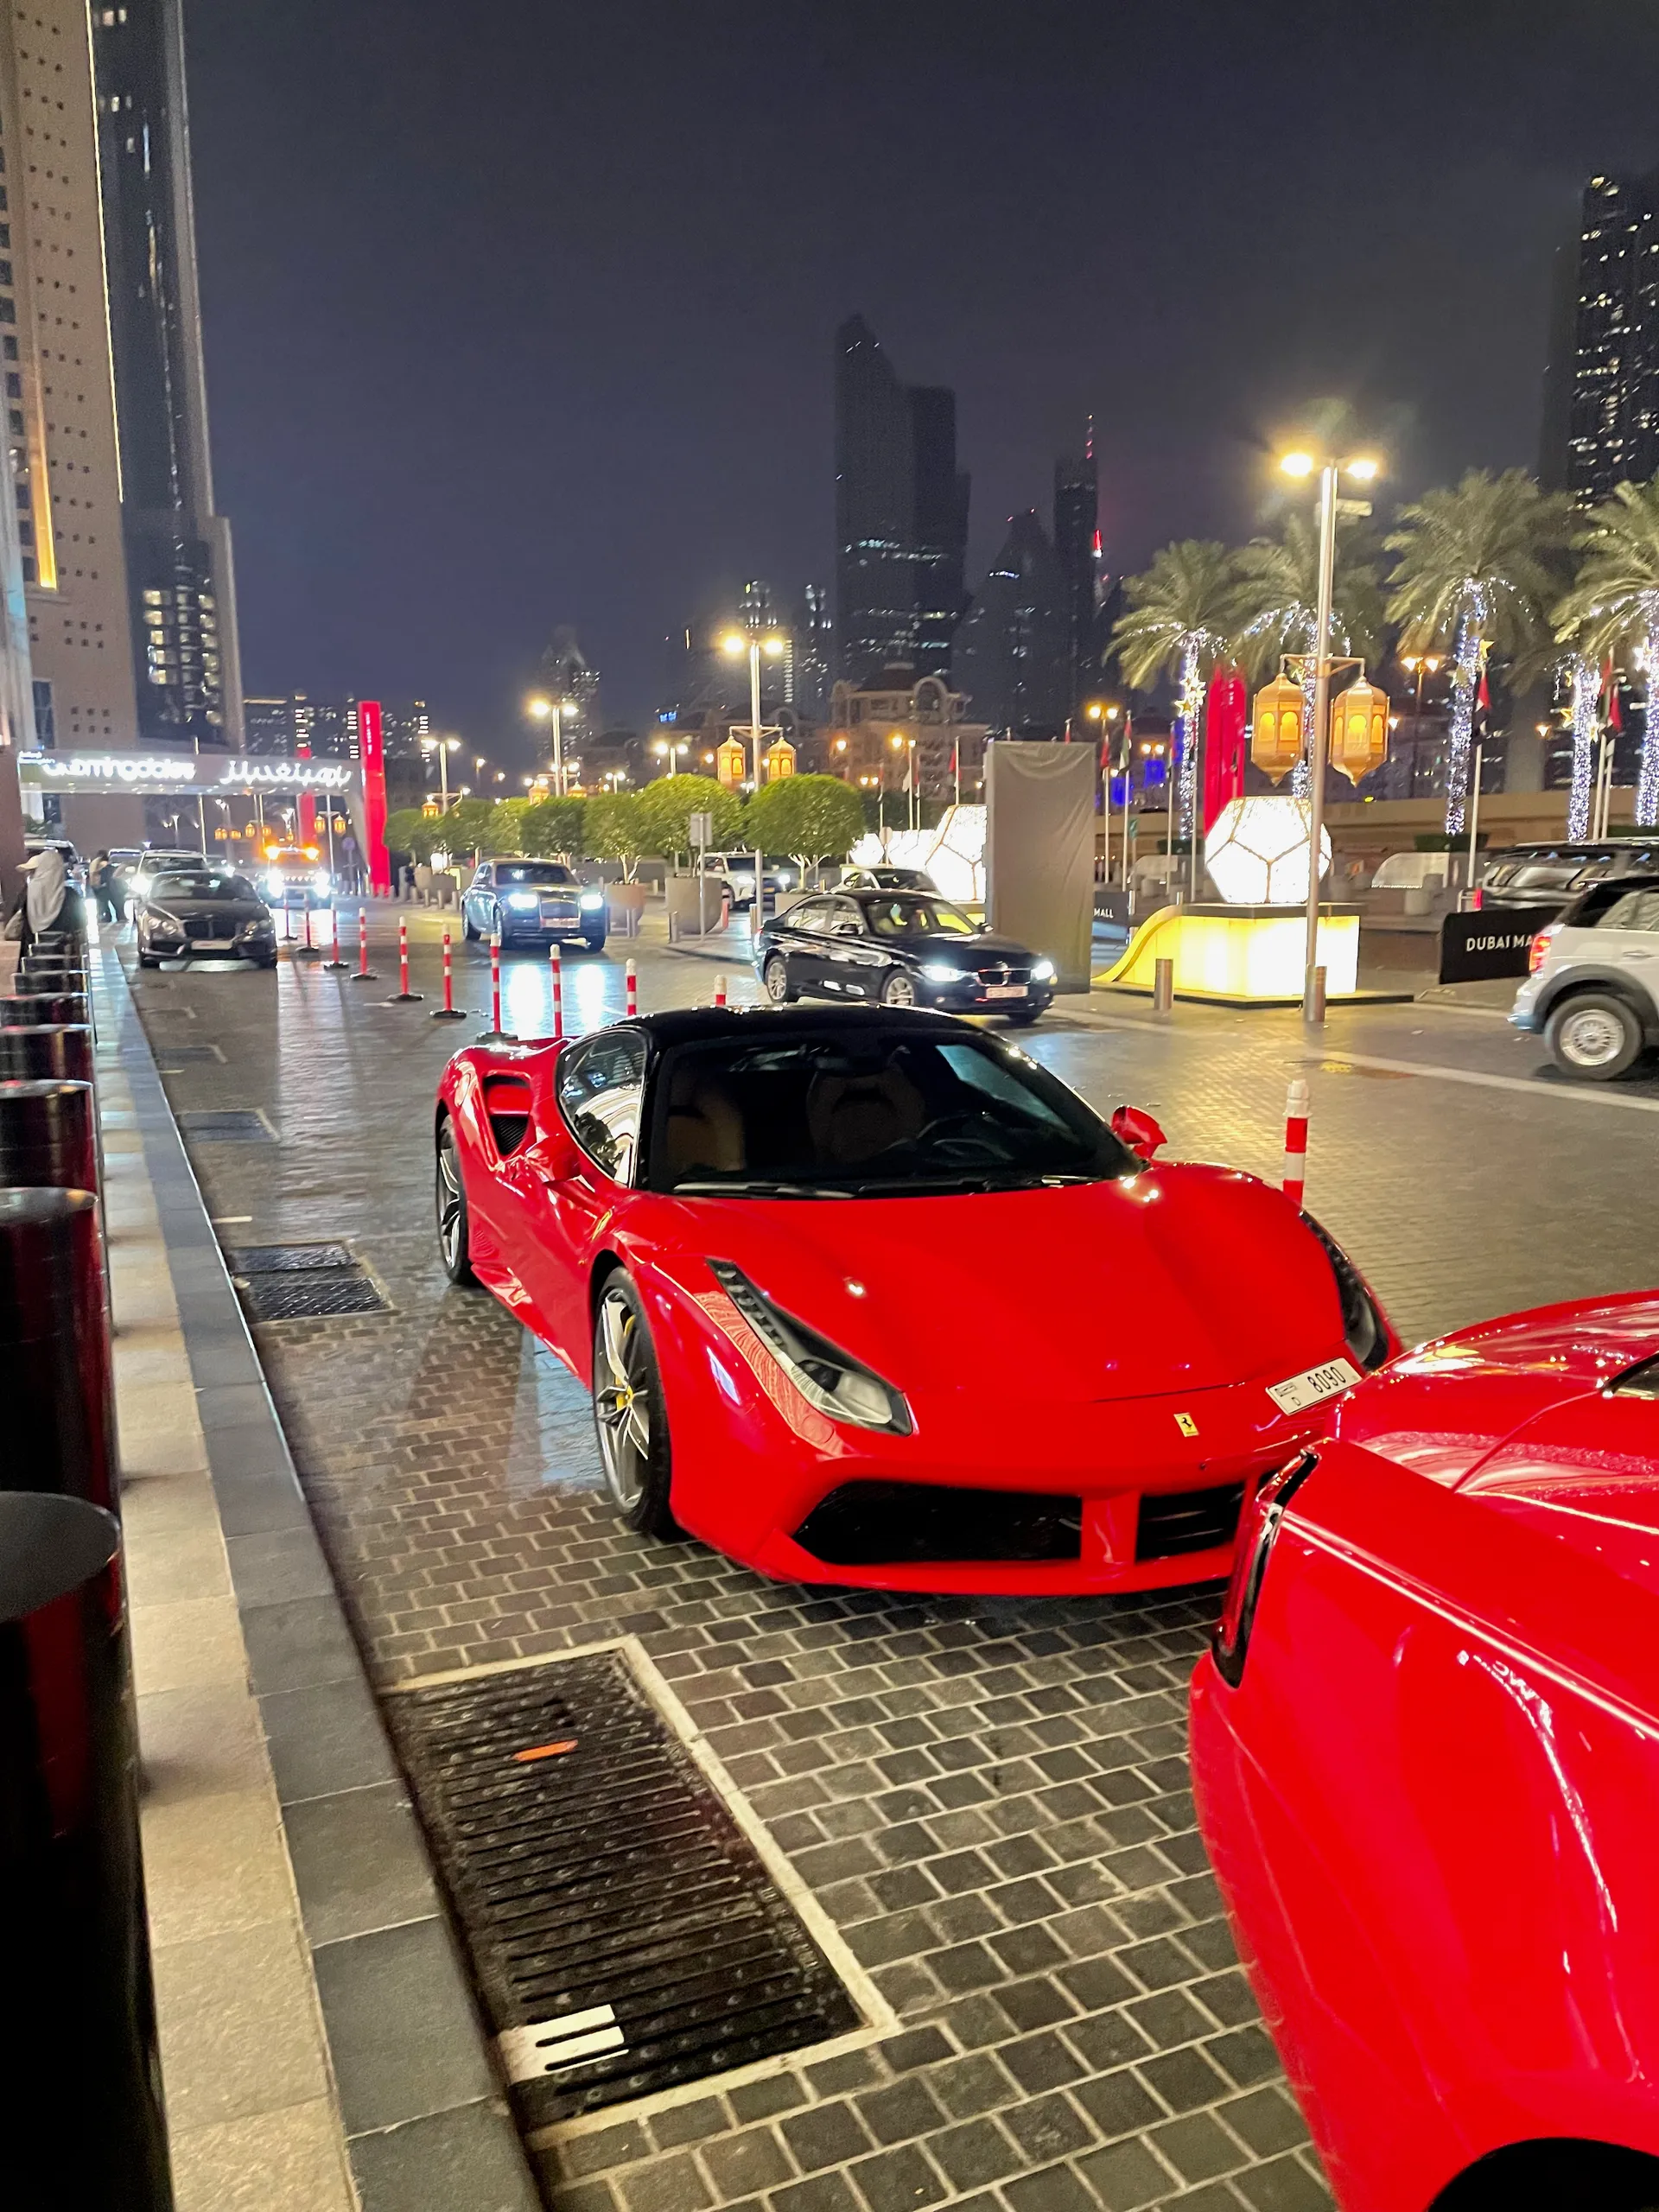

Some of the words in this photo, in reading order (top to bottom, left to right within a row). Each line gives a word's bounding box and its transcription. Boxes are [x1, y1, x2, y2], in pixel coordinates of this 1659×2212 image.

[1093, 907, 1114, 918] MALL
[1466, 935, 1511, 952] DUBAI
[1513, 934, 1533, 949] MA
[1307, 1366, 1346, 1393] 8090
[1291, 1396, 1301, 1407] D
